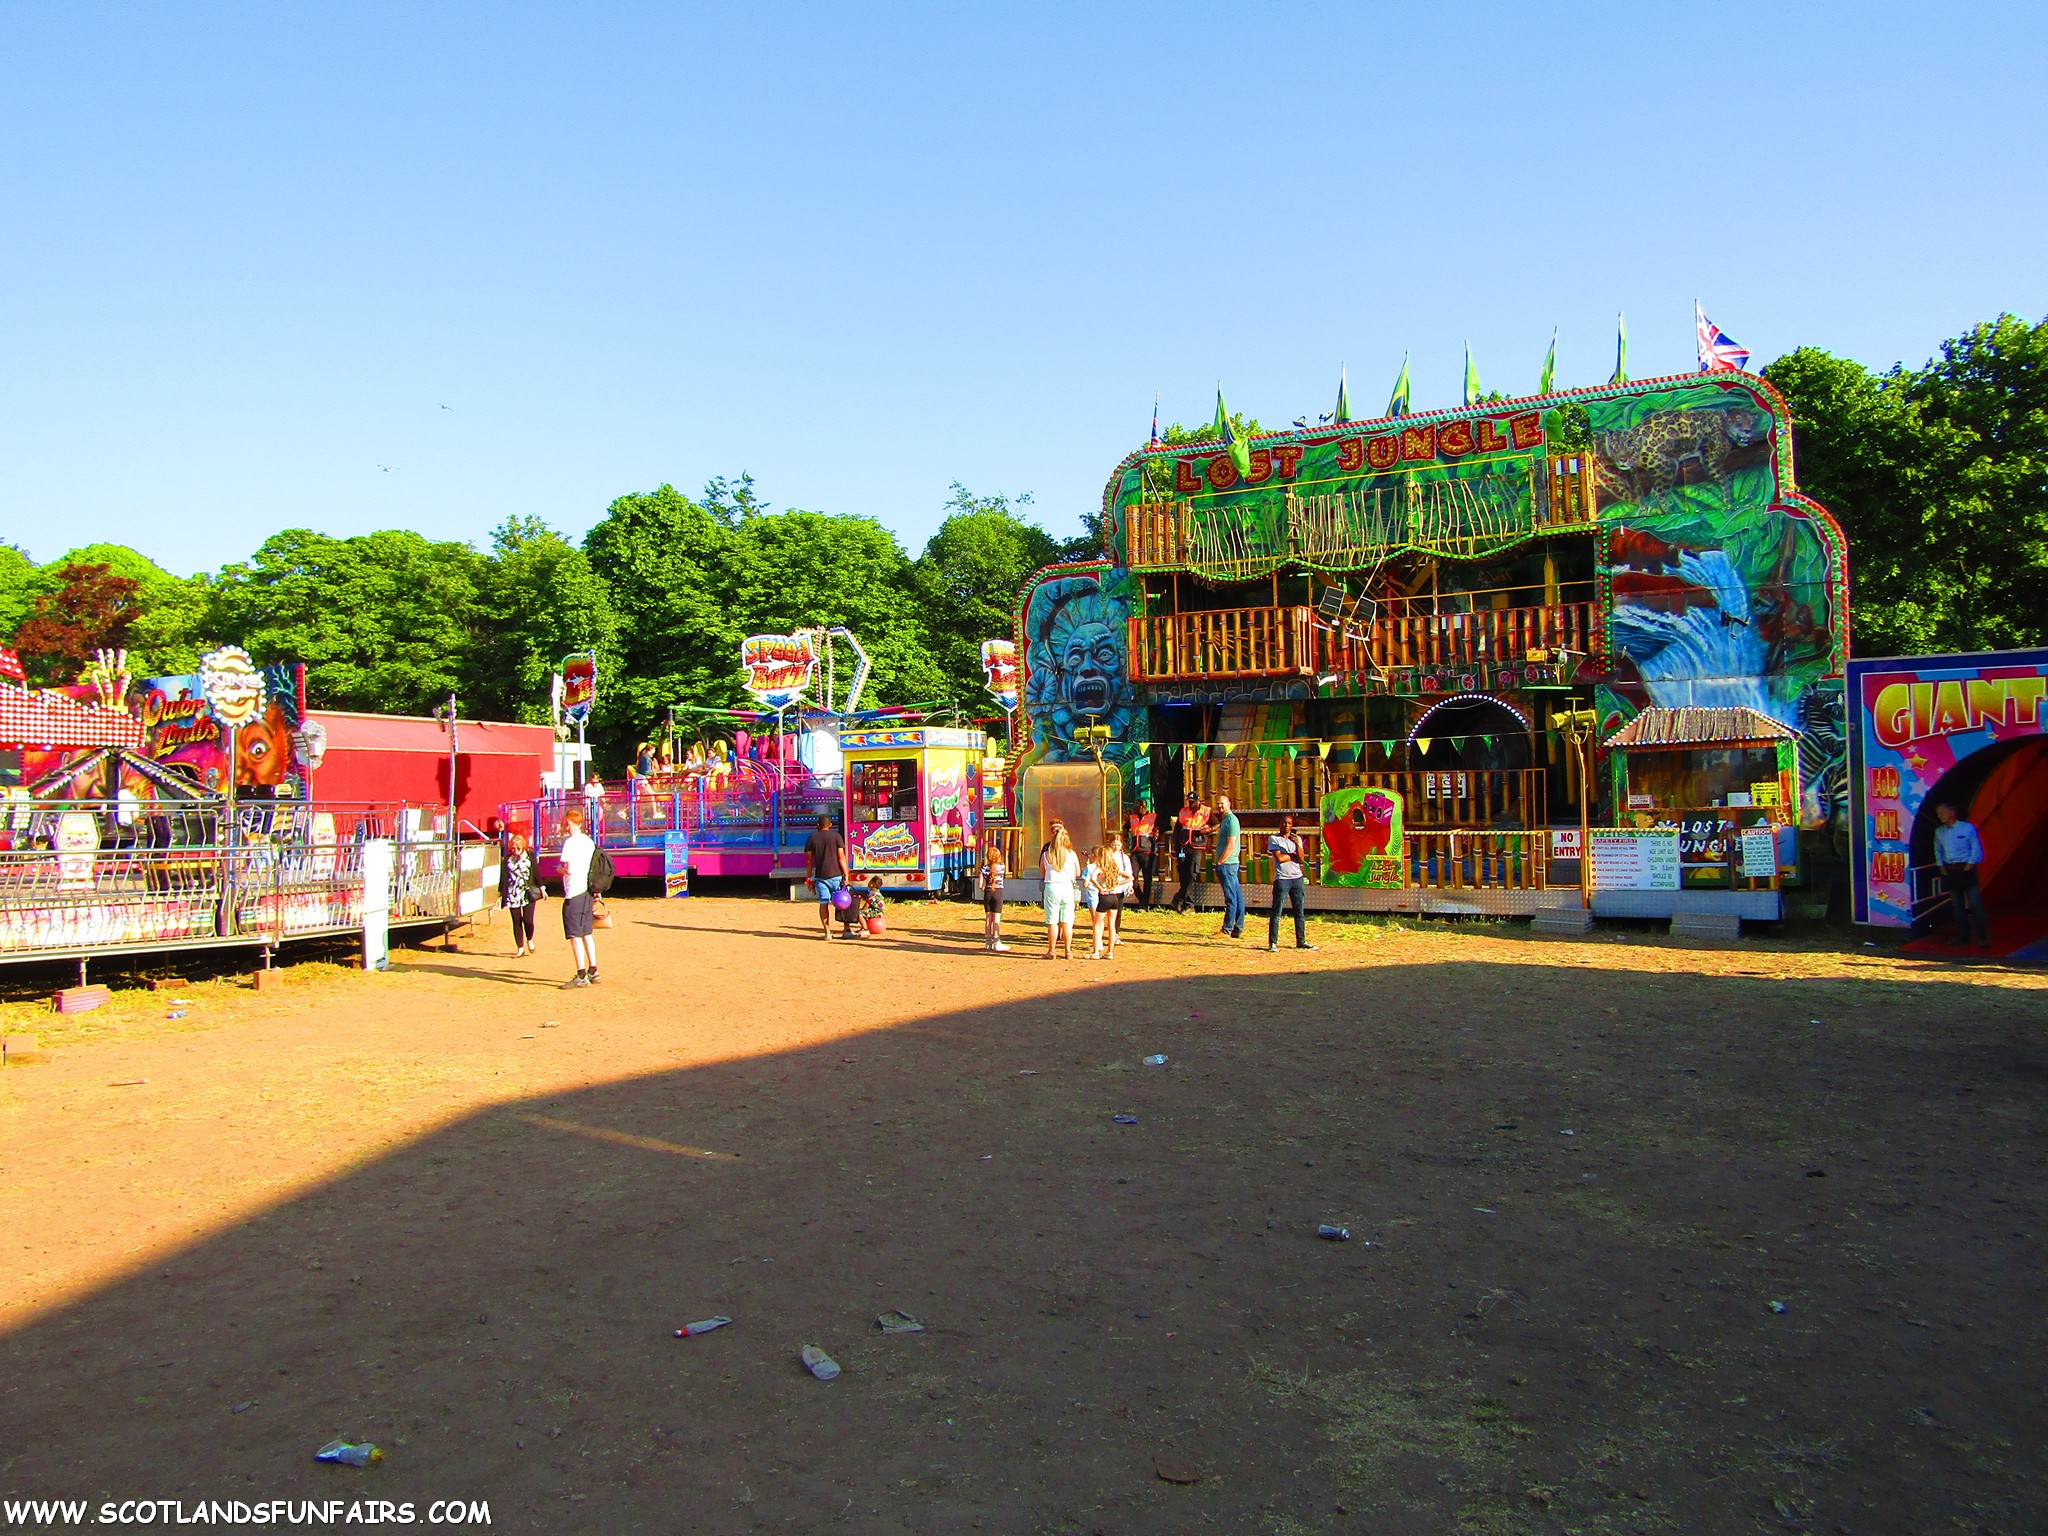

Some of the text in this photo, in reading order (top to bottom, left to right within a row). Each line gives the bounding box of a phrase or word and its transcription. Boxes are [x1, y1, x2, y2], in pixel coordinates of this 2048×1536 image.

[1175, 411, 1545, 493] LOST JUNGLE
[143, 688, 206, 727] Outer
[1873, 676, 2046, 747] GIANT
[153, 715, 220, 760] Limits
[1870, 767, 1899, 799] FOR
[931, 793, 959, 816] Crew
[1561, 832, 1574, 843] NO
[1681, 820, 1727, 834] LOST
[1874, 809, 1900, 841] ALL
[1553, 846, 1581, 857] ENTRY
[1679, 839, 1742, 853] UNGLE
[1367, 870, 1400, 885] Jungle
[1370, 861, 1396, 871] Lost
[1871, 851, 1905, 883] AGES
